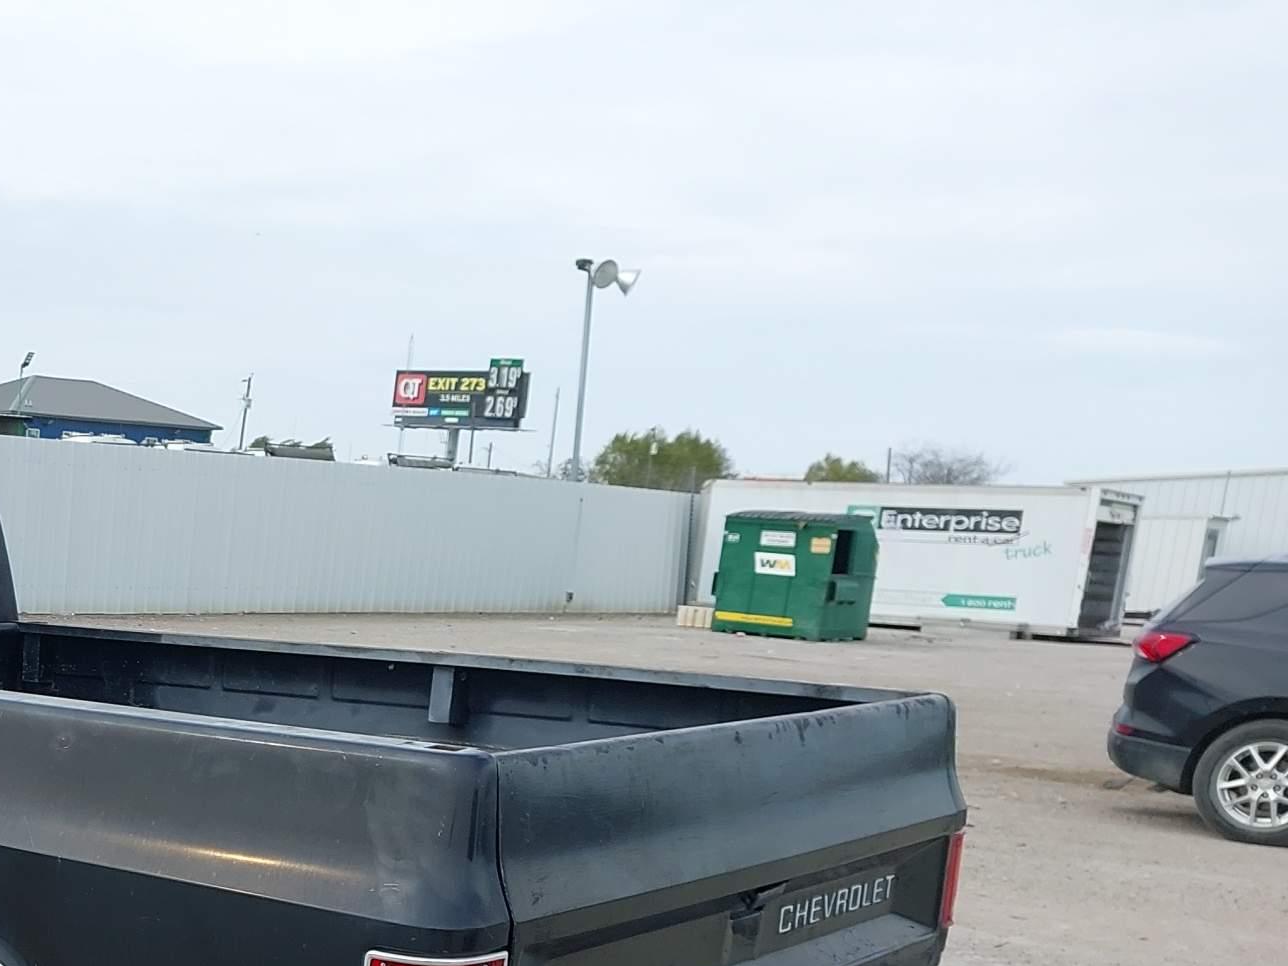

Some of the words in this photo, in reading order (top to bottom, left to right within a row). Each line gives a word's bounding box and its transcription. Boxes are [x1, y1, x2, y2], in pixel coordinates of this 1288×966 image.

[399, 378, 422, 400] QT
[428, 377, 458, 391] EXIT
[460, 377, 486, 391] 273
[881, 508, 1020, 533] Enterprise
[1004, 540, 1052, 560] truck
[760, 558, 790, 570] WM
[778, 875, 896, 933] CHEVROLET
